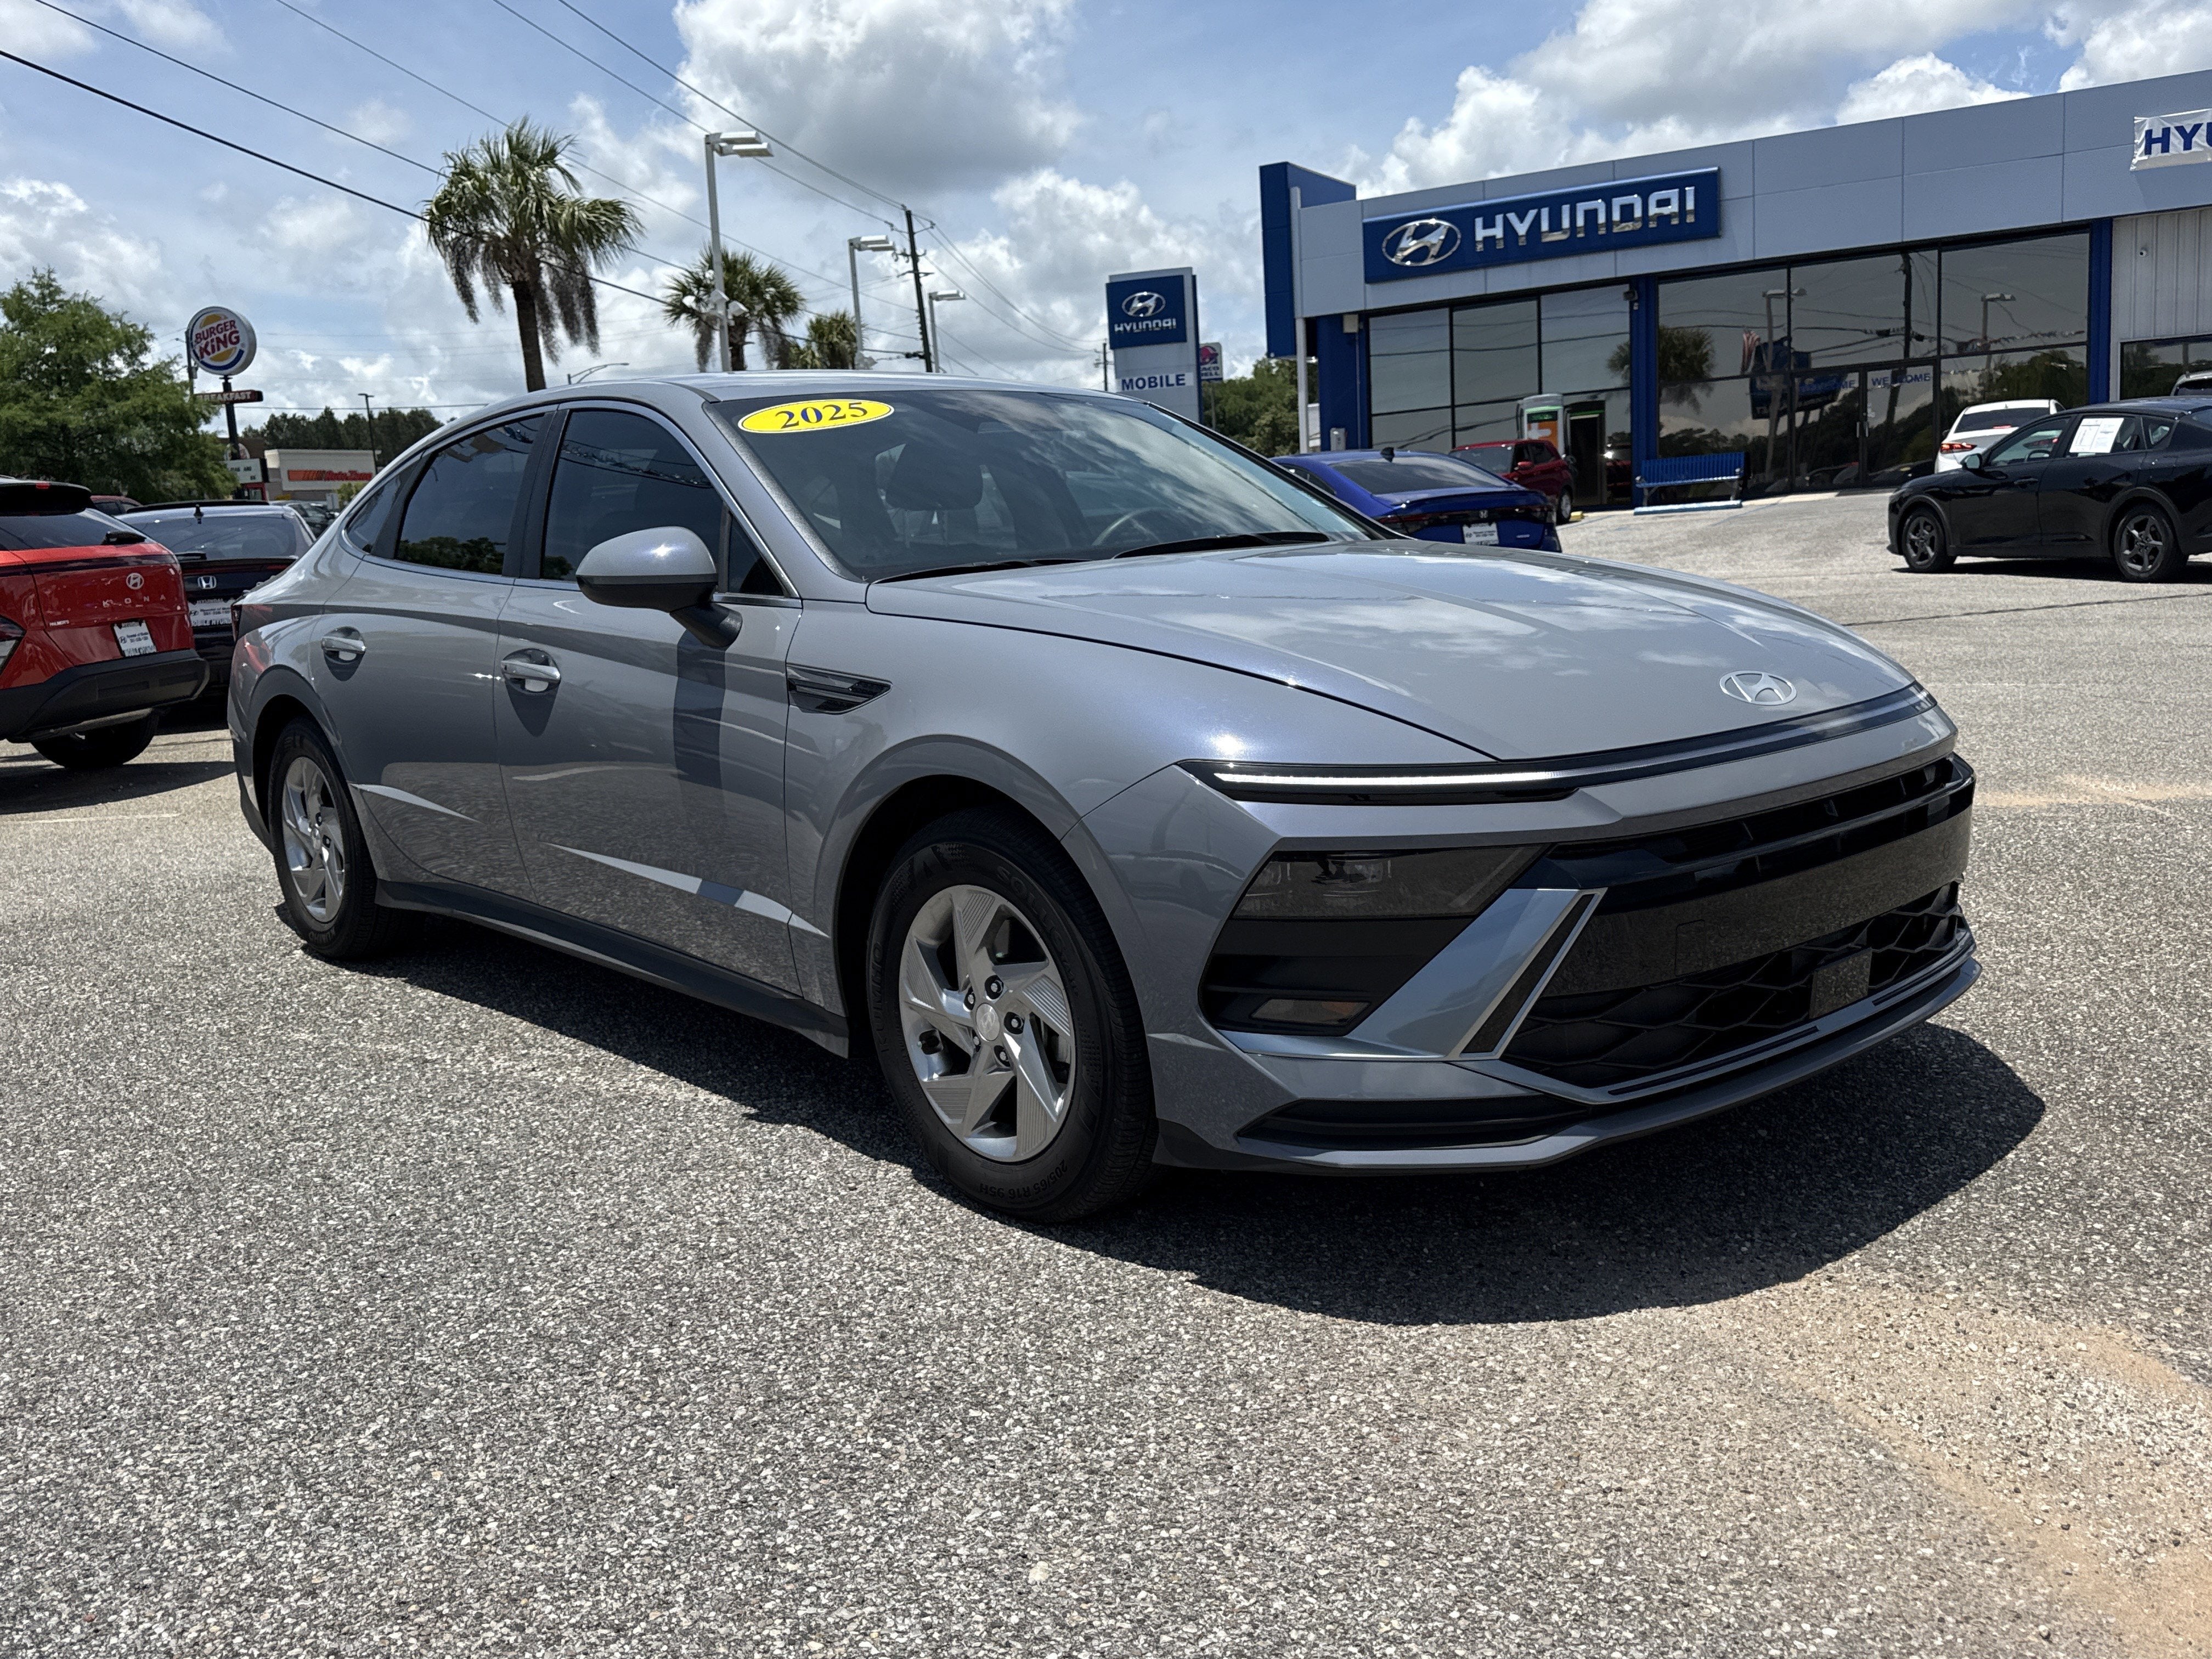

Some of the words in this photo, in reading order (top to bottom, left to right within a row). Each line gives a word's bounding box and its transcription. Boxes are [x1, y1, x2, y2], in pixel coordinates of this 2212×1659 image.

[2144, 122, 2212, 155] HY
[1475, 186, 1695, 252] HYUNDAI
[195, 320, 237, 344] BURGER
[1114, 318, 1177, 334] HYUNDAI
[199, 330, 240, 359] KING
[1121, 374, 1186, 391] MOBILE
[775, 402, 867, 429] 2025
[103, 594, 166, 608] KONA
[872, 940, 889, 1053] KUMHO
[1032, 1159, 1068, 1195] 205/65
[979, 1183, 1005, 1199] 95H
[1008, 1186, 1031, 1199] R16
